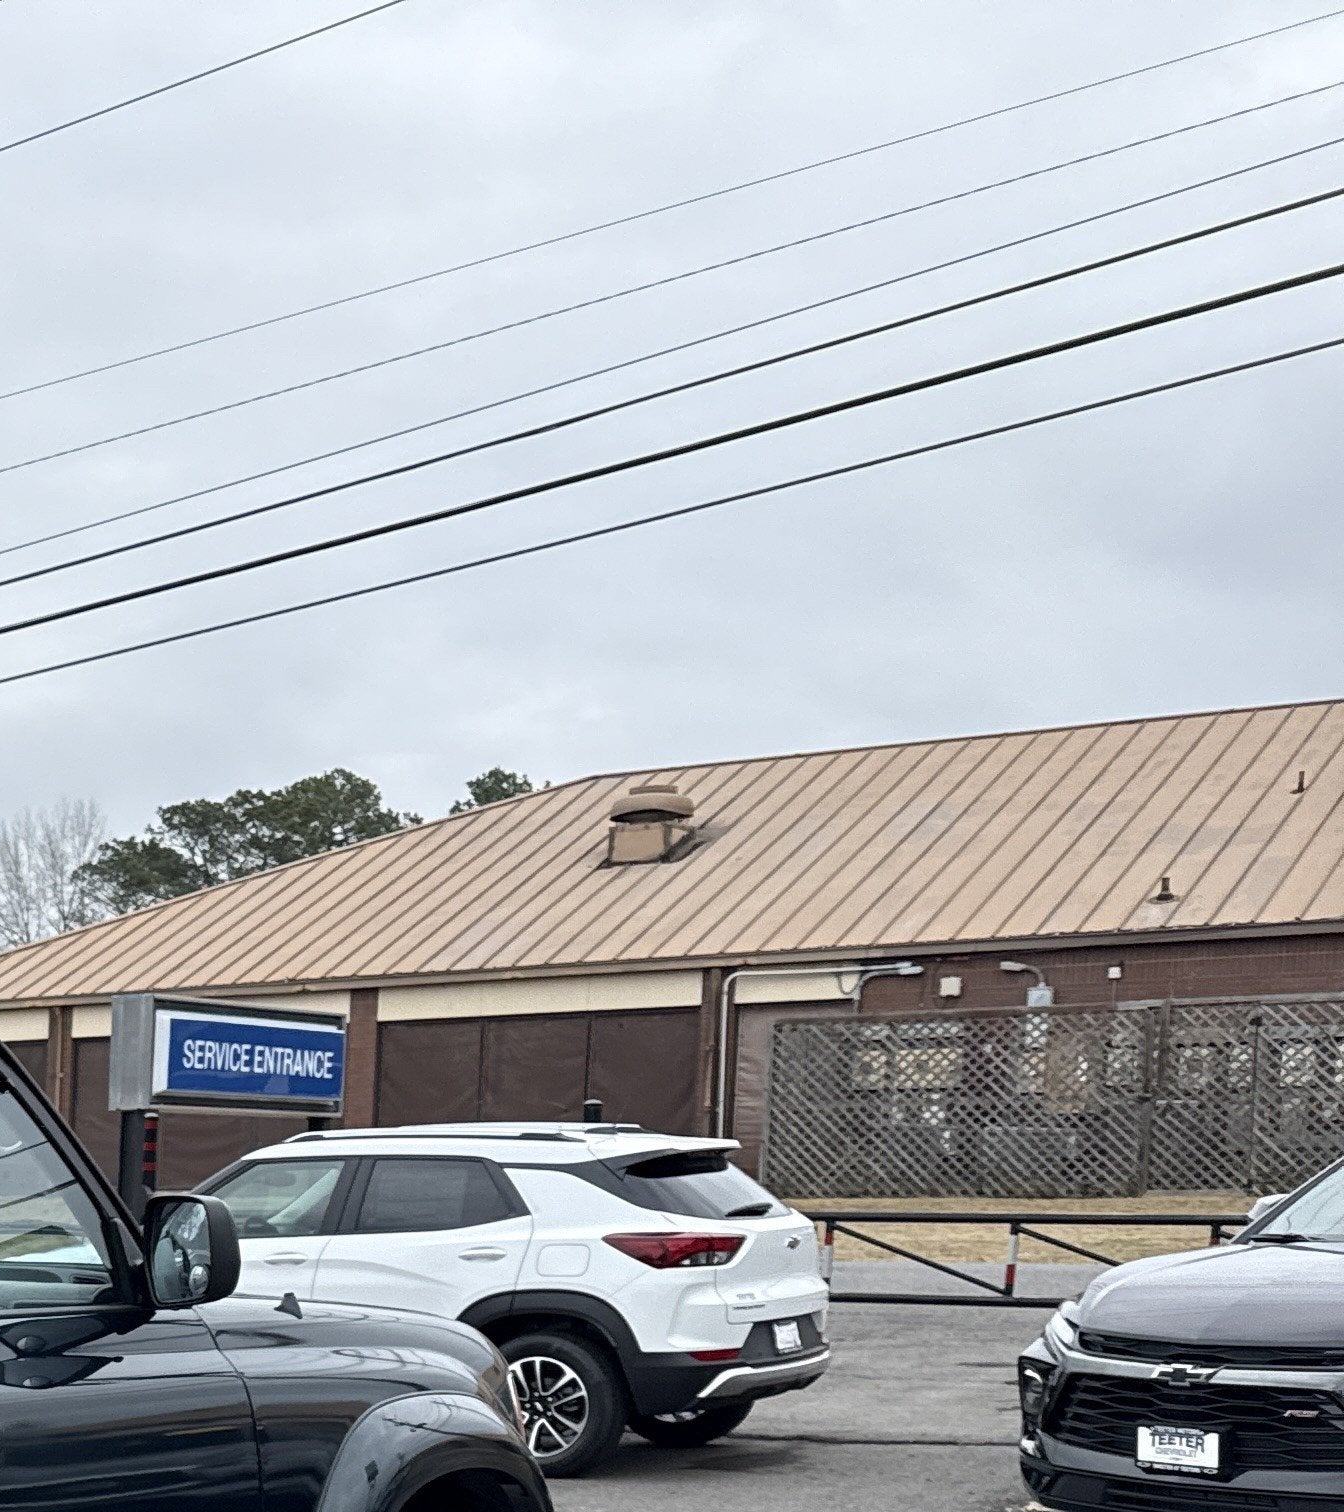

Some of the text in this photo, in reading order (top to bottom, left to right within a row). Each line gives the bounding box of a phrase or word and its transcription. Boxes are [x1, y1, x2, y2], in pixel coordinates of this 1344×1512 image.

[182, 1039, 334, 1079] SERVICE ENTRANCE
[1149, 1431, 1205, 1453] TEETER
